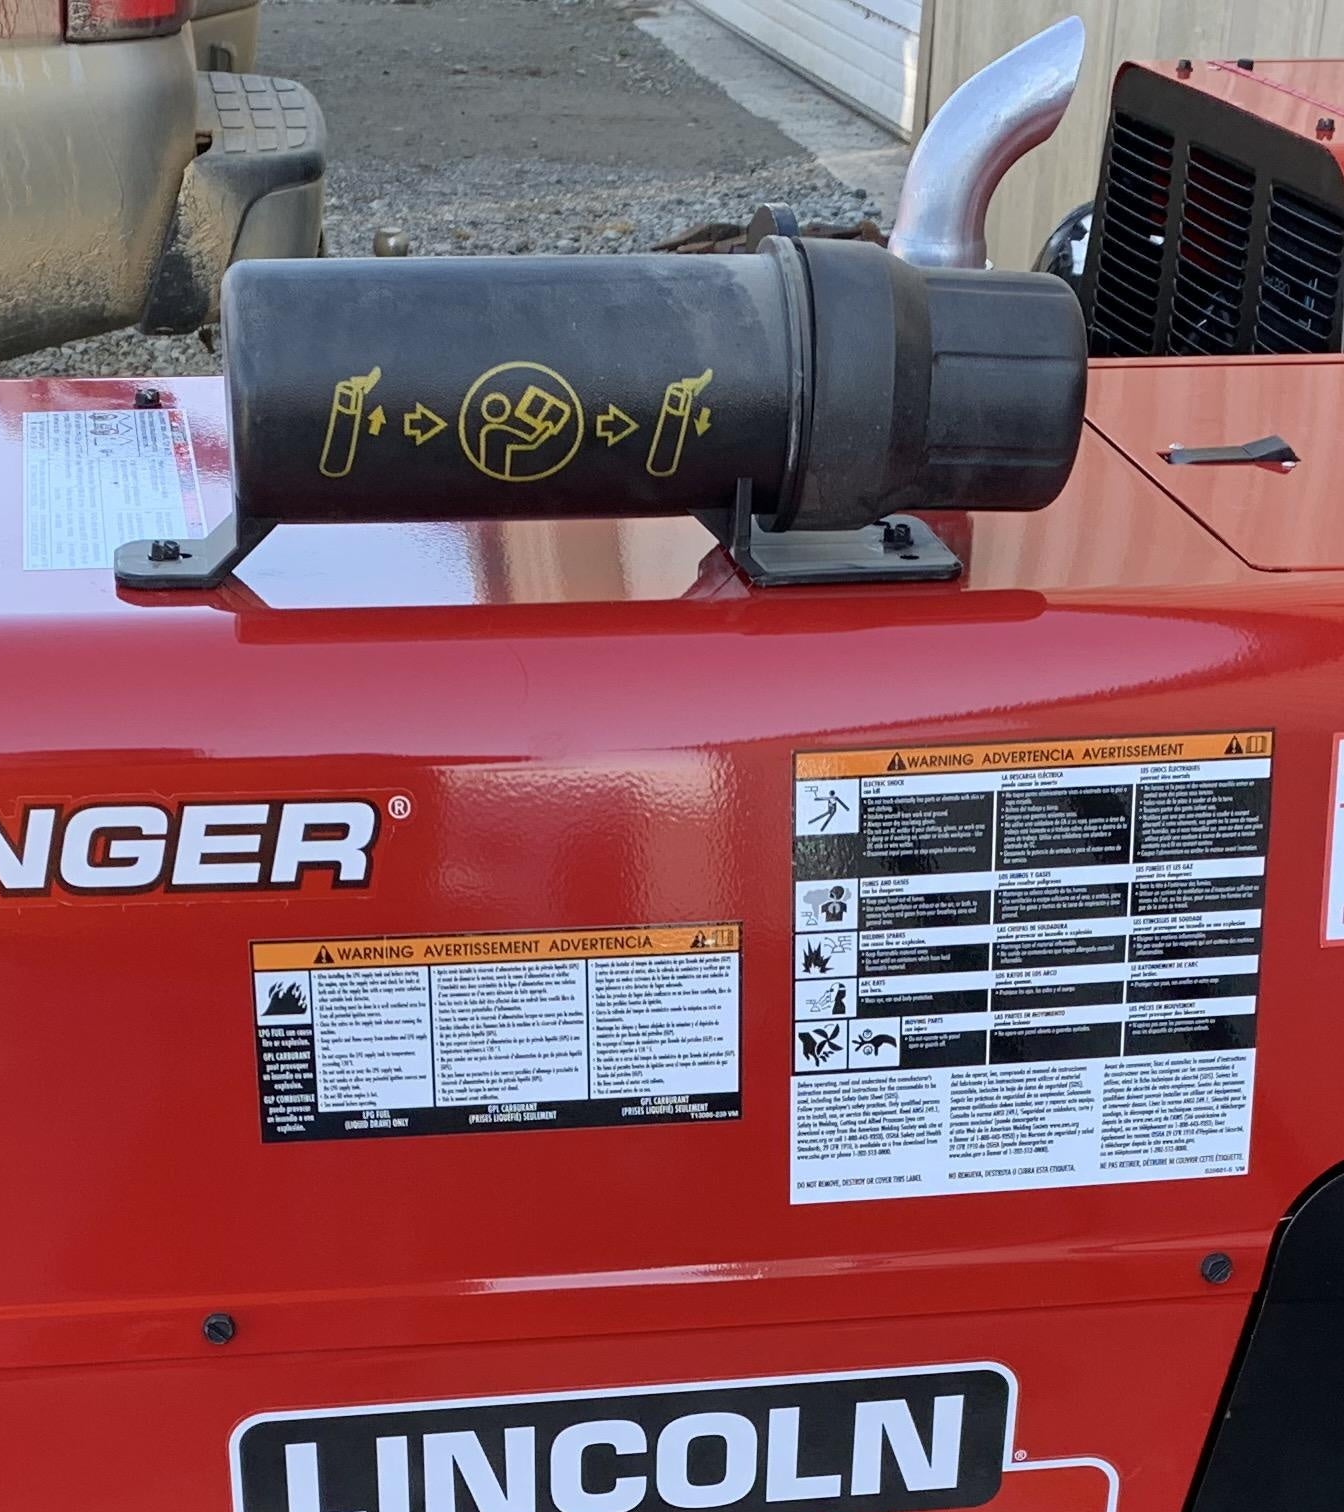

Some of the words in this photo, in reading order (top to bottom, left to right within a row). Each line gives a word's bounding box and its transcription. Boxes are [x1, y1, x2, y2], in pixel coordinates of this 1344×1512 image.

[907, 754, 973, 768] WARNING
[982, 748, 1074, 765] ADVERTENCIA
[1082, 743, 1184, 761] AVERTISSEMENT
[337, 945, 414, 960] WARNING
[424, 940, 540, 958] AVERTISSEMENT
[549, 935, 654, 952] ADVERTENCIA
